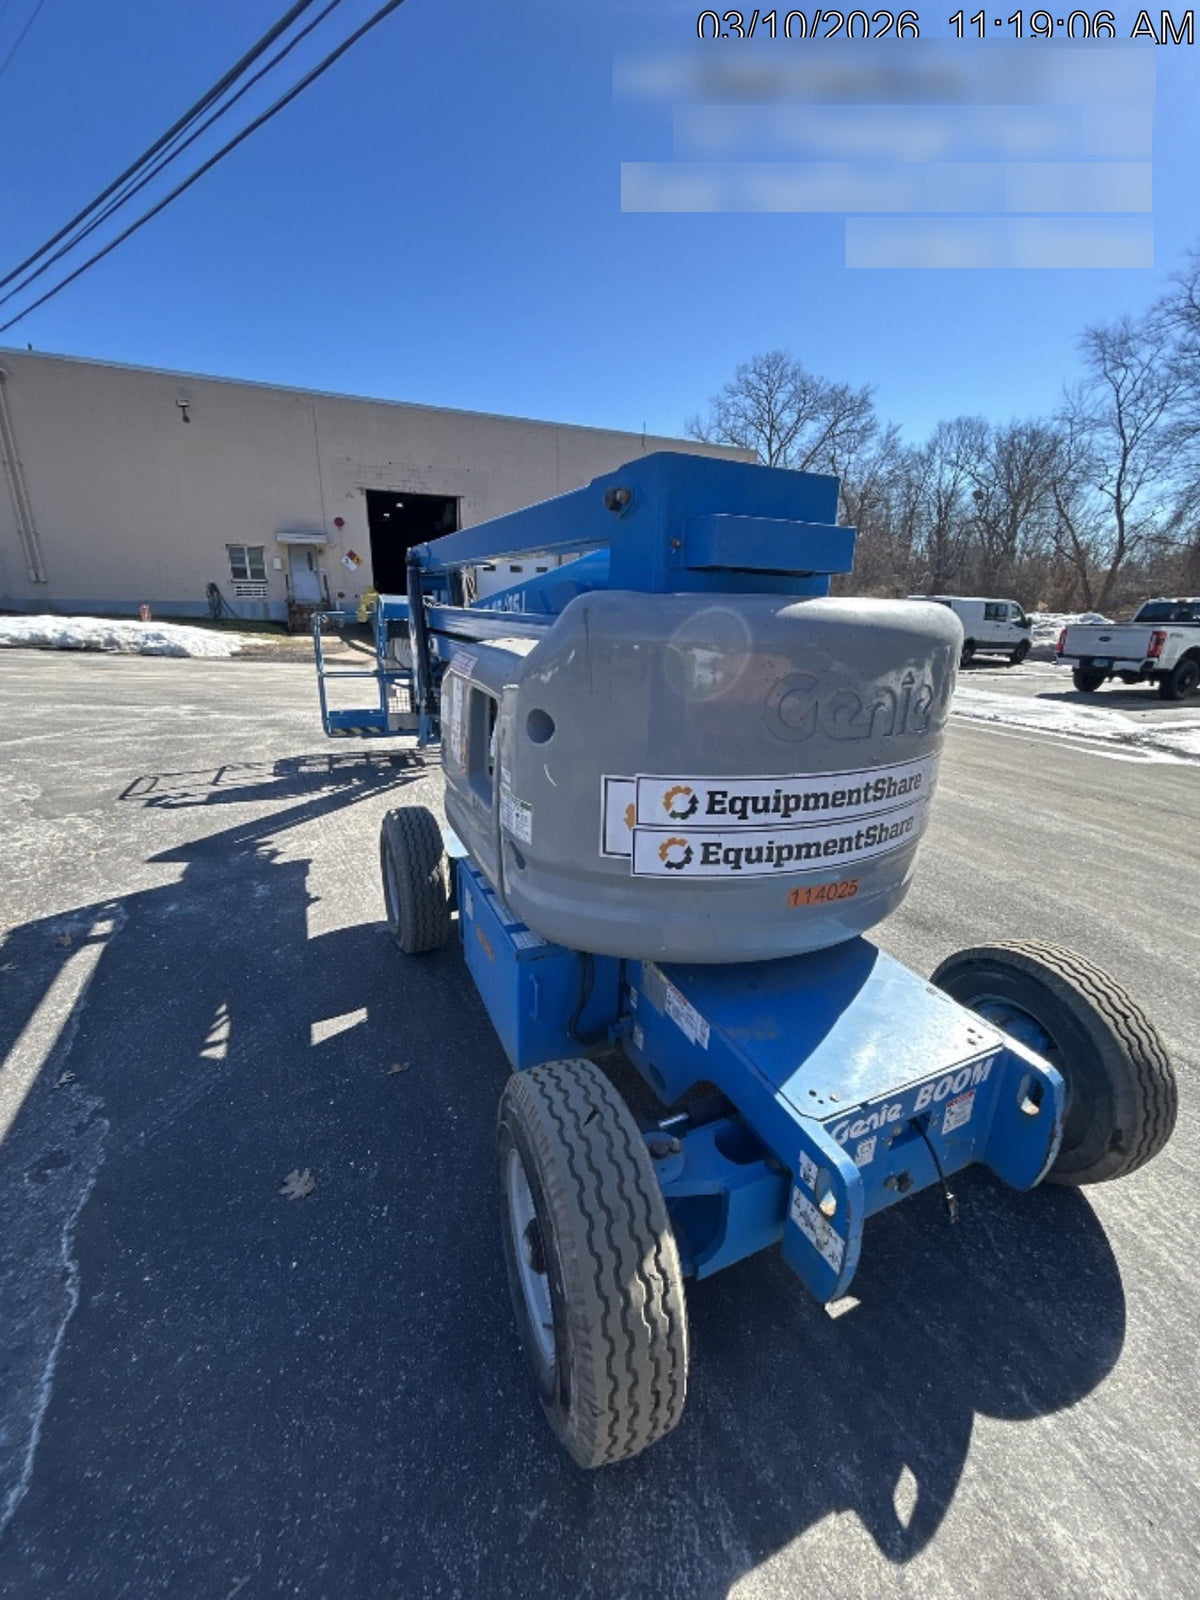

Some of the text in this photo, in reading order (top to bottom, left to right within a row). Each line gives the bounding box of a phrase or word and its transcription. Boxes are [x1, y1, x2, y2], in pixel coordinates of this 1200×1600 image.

[764, 671, 933, 744] Genie
[705, 773, 922, 819] EquipmentShare
[700, 816, 914, 870] EquipmentShare
[791, 879, 859, 906] 114025
[831, 1103, 902, 1146] Genie
[913, 1057, 994, 1112] BOOM
